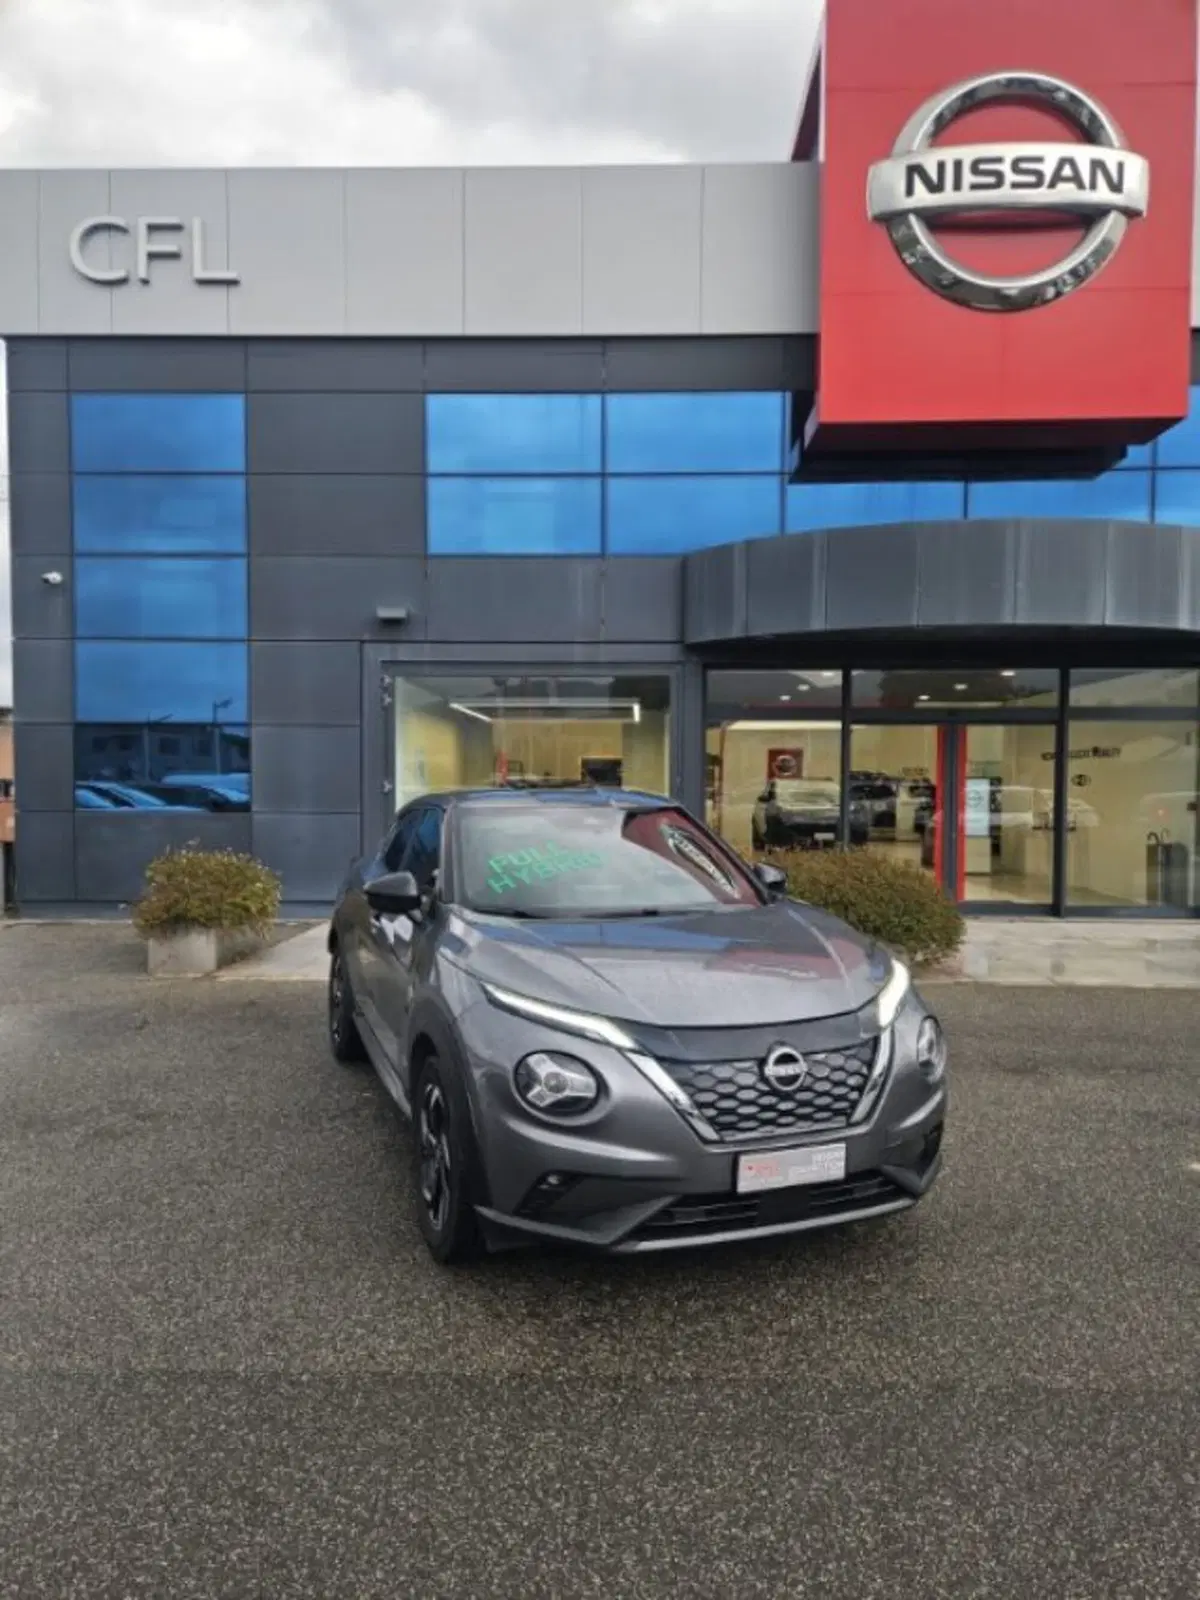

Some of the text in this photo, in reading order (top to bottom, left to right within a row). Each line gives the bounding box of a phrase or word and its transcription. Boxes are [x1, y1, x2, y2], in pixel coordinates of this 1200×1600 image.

[905, 156, 1124, 198] NISSAN
[69, 215, 240, 285] CFL
[488, 840, 568, 873] FULL
